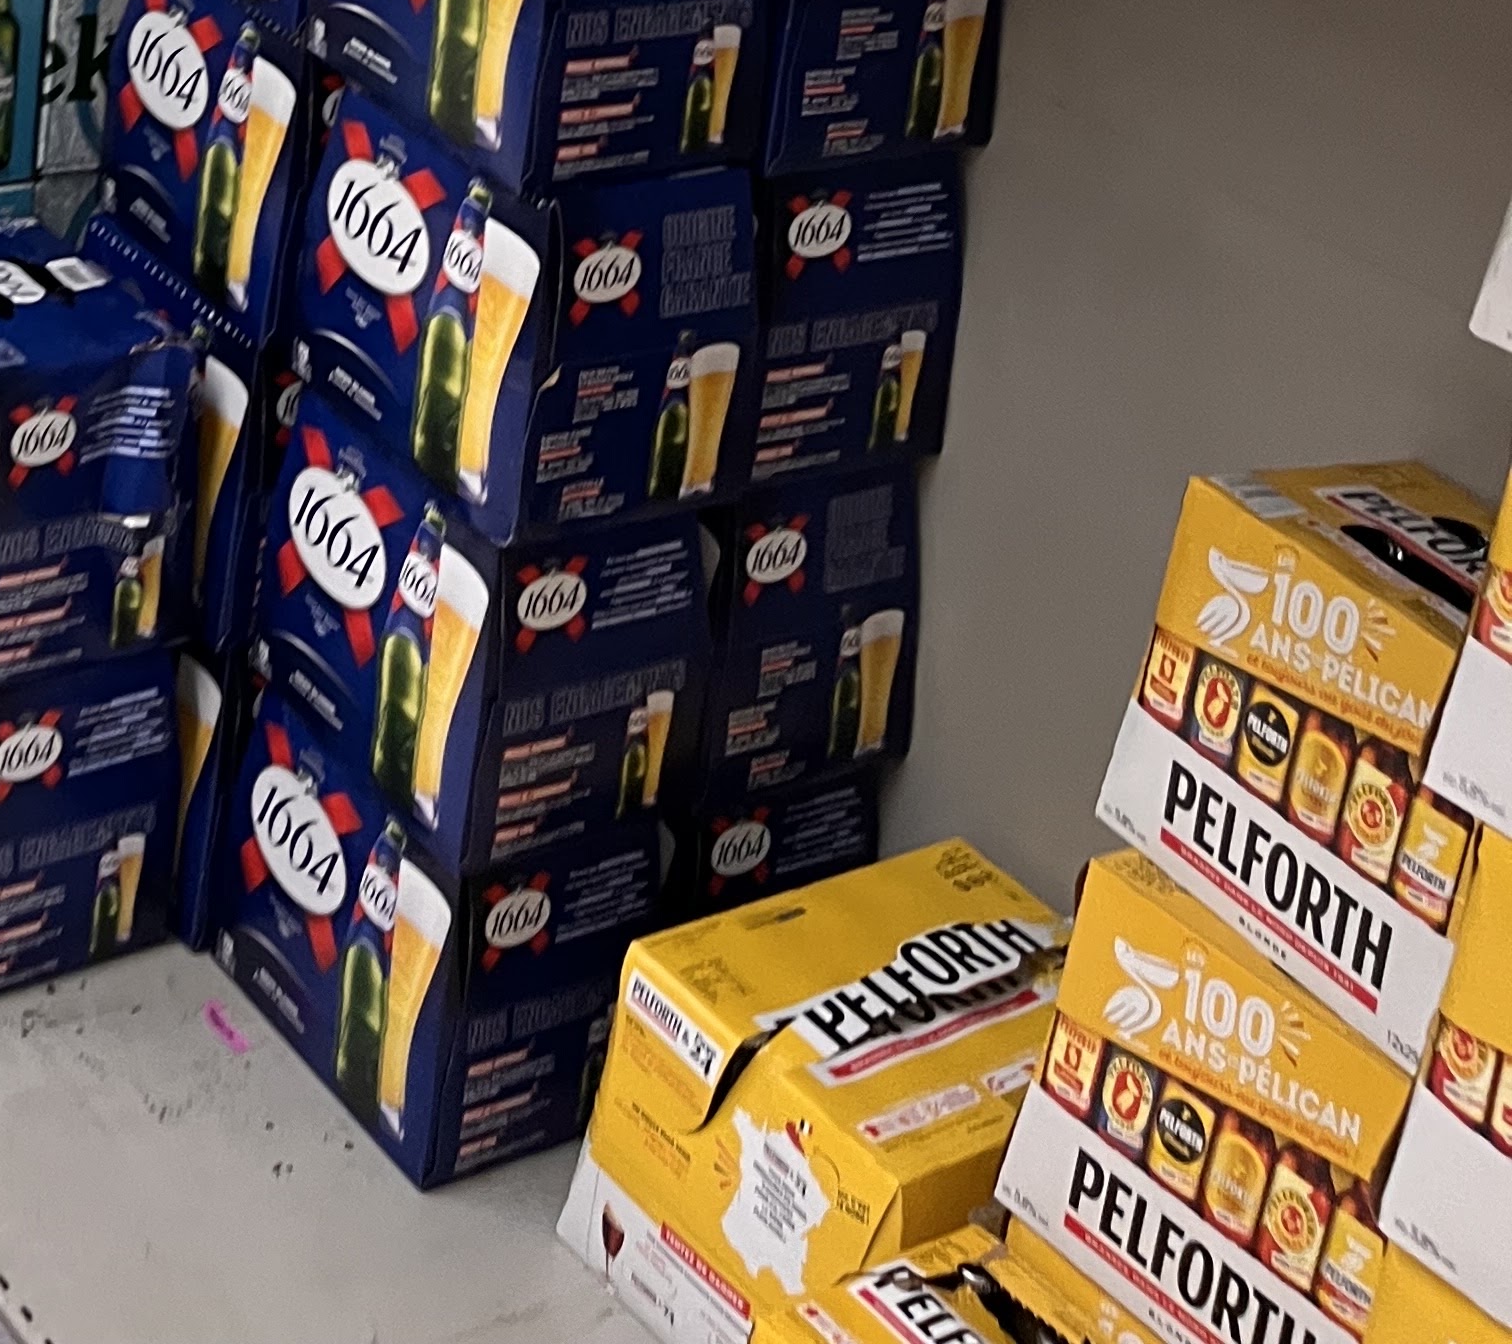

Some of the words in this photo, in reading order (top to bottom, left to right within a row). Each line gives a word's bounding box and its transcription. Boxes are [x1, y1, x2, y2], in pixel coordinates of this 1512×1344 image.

[133, 31, 205, 113] 1664
[334, 178, 425, 276] 1664
[794, 212, 847, 248] 1664
[579, 255, 637, 293] 1664
[17, 423, 70, 456] 1664
[294, 485, 382, 591] 1664
[749, 540, 802, 573] 1664
[522, 581, 584, 618] 1664
[1272, 572, 1361, 655] 100
[1246, 712, 1289, 752] PELFORTH
[3, 736, 56, 771] 1664
[258, 784, 343, 899] 1664
[717, 833, 767, 867] 1664
[1164, 760, 1393, 993] PELFORTH
[1400, 853, 1448, 892] PELFORTH
[492, 900, 547, 937] 1664
[804, 920, 1042, 1052] PELFORTH
[1184, 969, 1276, 1058] 100
[1158, 1106, 1204, 1154] PELFORTH
